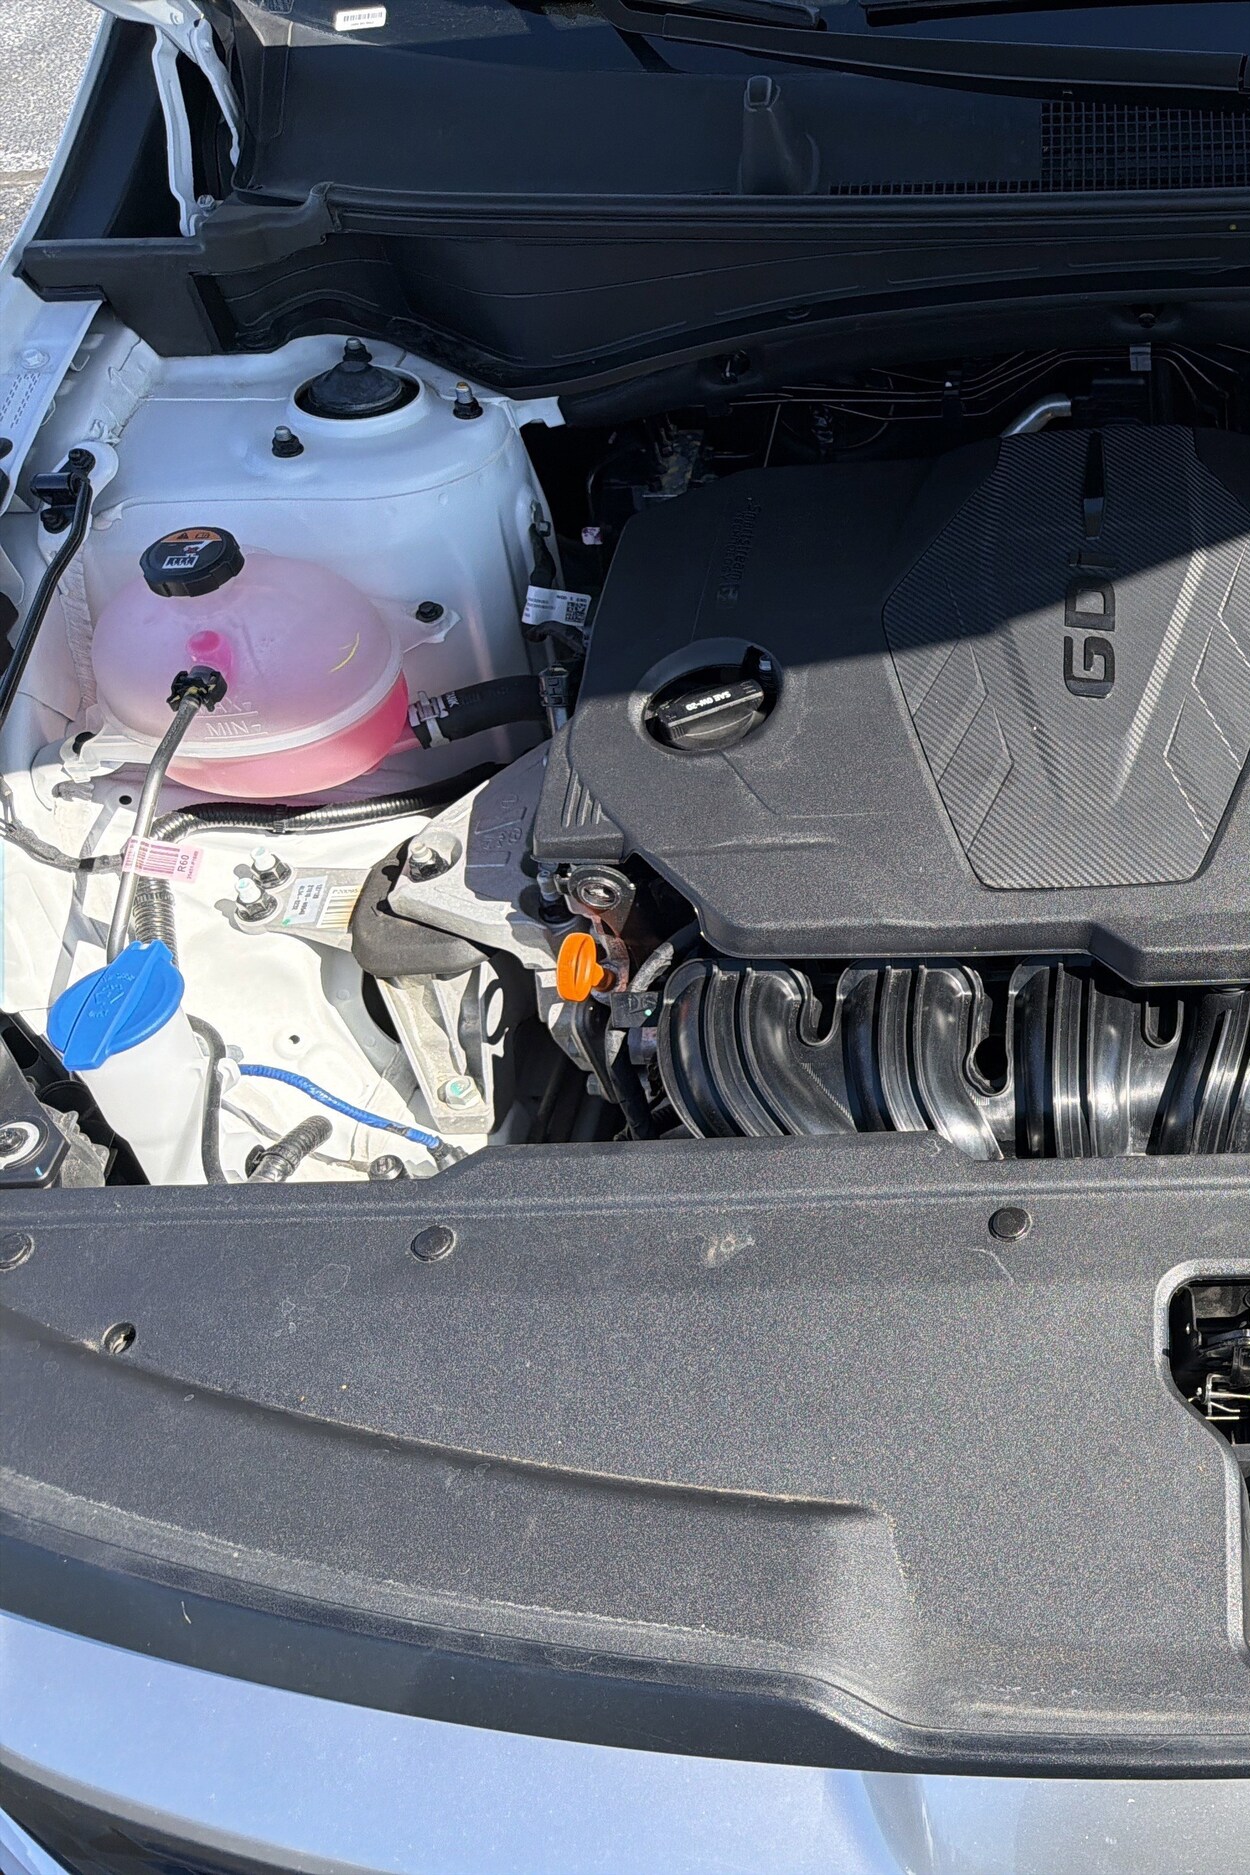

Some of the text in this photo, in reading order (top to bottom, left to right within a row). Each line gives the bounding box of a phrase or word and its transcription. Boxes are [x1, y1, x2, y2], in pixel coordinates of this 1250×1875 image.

[1063, 550, 1116, 699] GDI
[713, 690, 732, 702] SAE
[206, 721, 249, 736] MIN
[177, 854, 189, 872] R60
